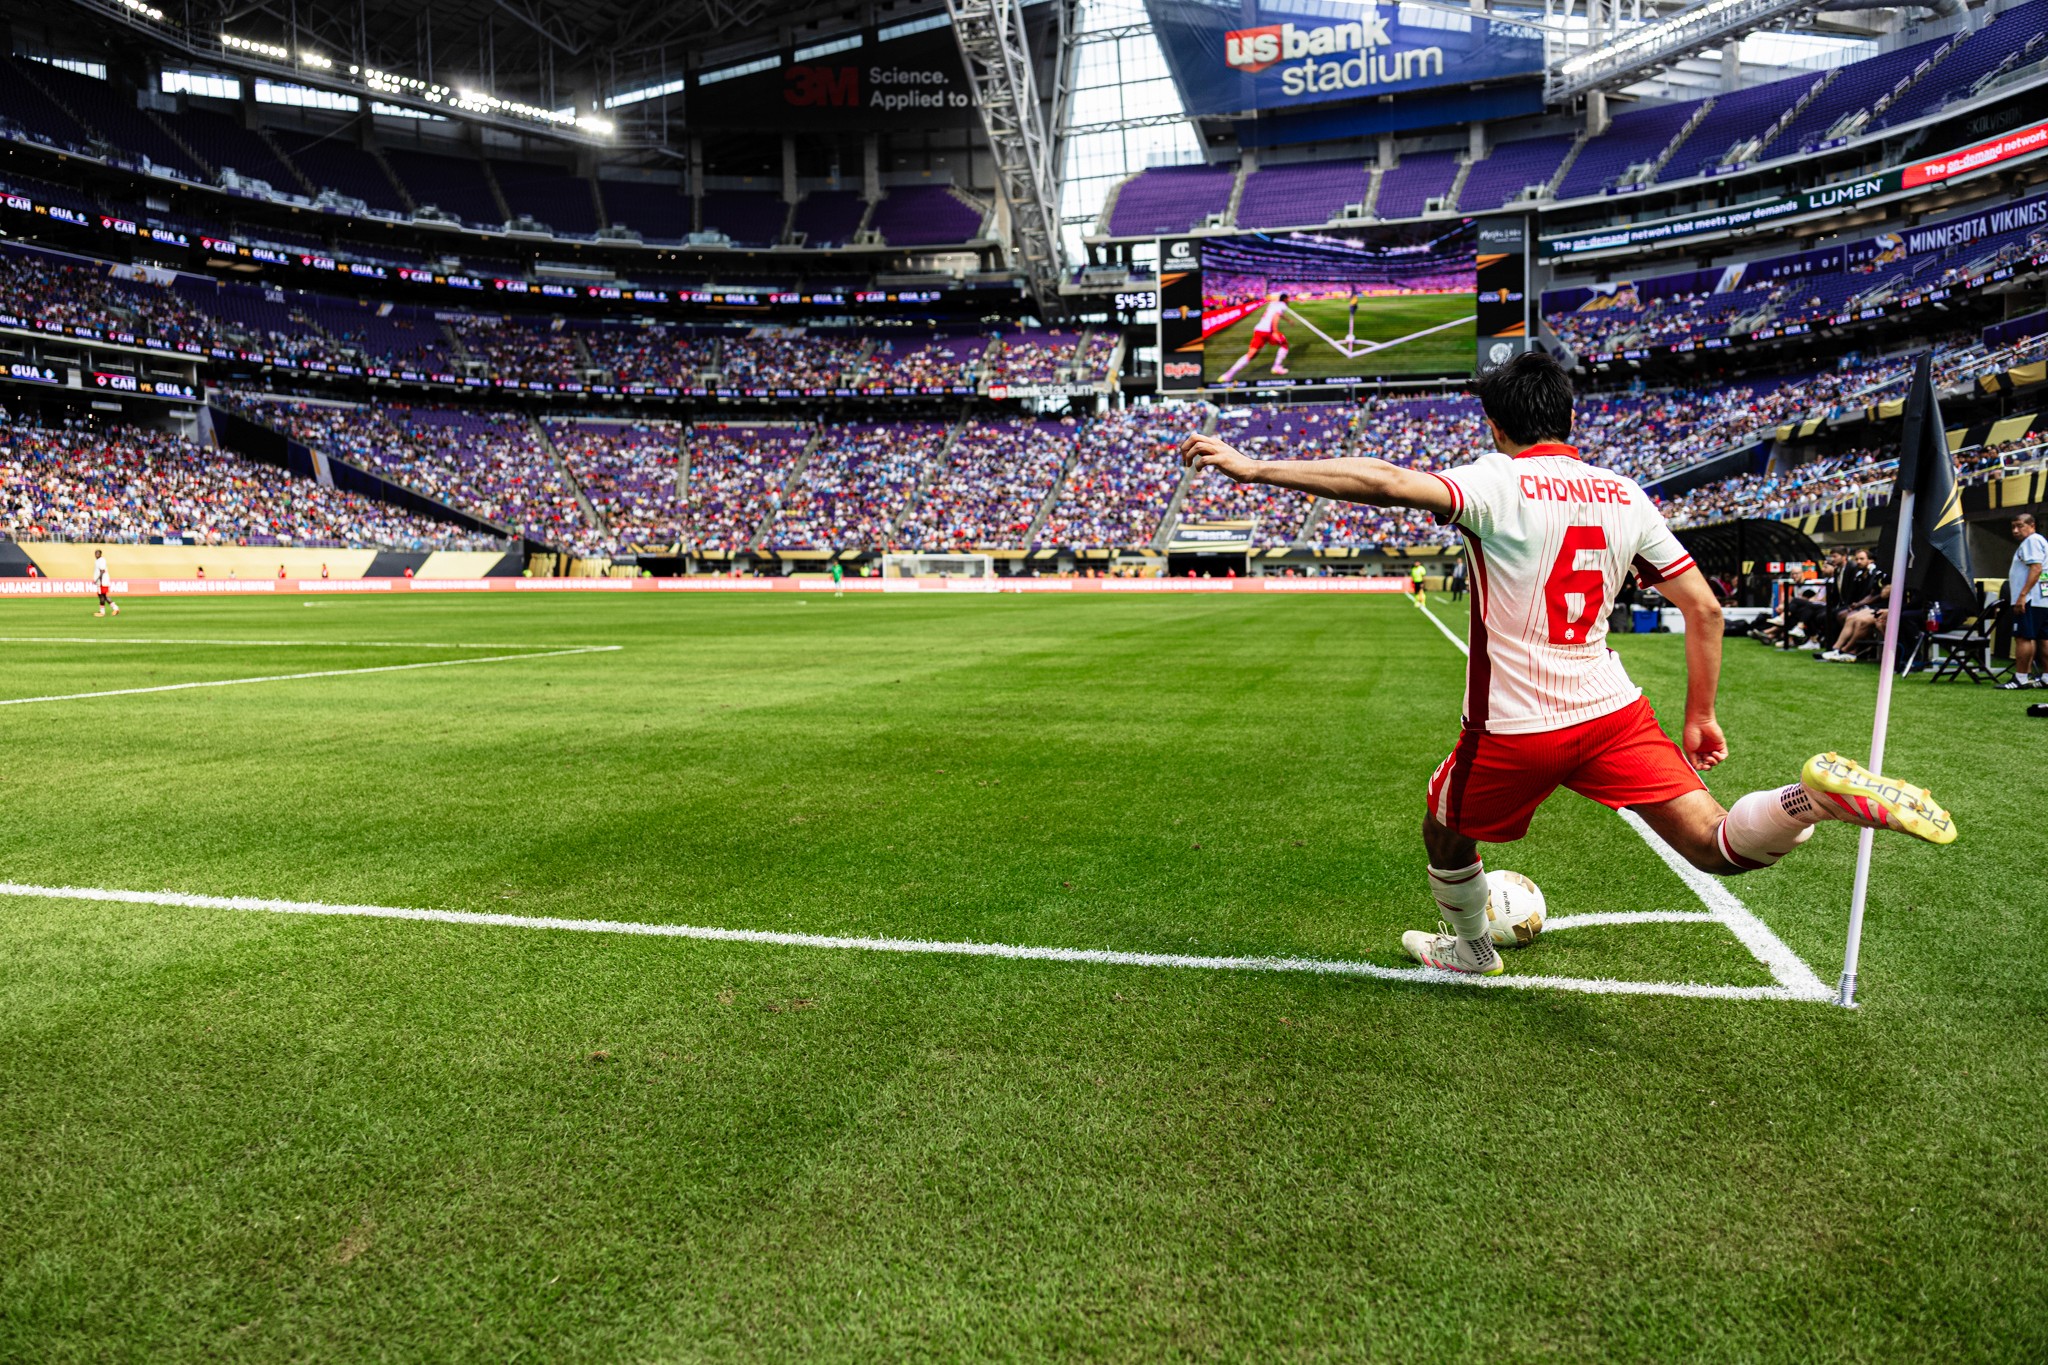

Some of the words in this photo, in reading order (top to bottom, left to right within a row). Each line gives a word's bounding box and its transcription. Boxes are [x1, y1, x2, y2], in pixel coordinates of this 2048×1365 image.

[870, 67, 949, 84] Science.
[1282, 46, 1443, 96] stadium
[784, 66, 860, 107] 3M
[870, 90, 944, 111] Applied
[947, 92, 968, 107] to
[1925, 163, 1945, 177] The
[1947, 143, 2003, 174] on-demand
[2004, 129, 2047, 153] network
[1809, 178, 1881, 209] LUMEN
[7, 196, 31, 211] CAN
[49, 206, 74, 220] GUA
[114, 221, 136, 235] CAN
[152, 229, 175, 242] GUA
[1552, 240, 1572, 252] The
[1573, 232, 1629, 250] on-demand
[1631, 226, 1672, 241] network
[1673, 220, 1693, 234] that
[1695, 215, 1727, 230] meets
[1728, 211, 1752, 226] your
[1752, 200, 1798, 219] demands
[1910, 216, 1988, 254] MINNESOTA
[1990, 200, 2047, 234] VIKINGS
[213, 240, 236, 254] CAN
[252, 248, 275, 262] GUA
[313, 258, 335, 271] CAN
[351, 263, 373, 275] GUA
[1772, 257, 1811, 276] HOME
[1821, 256, 1839, 269] OF
[1849, 249, 1875, 263] THE
[411, 272, 432, 283] CAN
[448, 276, 470, 288] GUA
[506, 281, 528, 293] CAN
[542, 285, 564, 296] GUA
[599, 288, 620, 299] CAN
[635, 290, 656, 301] GUA
[1115, 292, 1156, 309] 54:53
[11, 364, 40, 379] GUA
[110, 376, 137, 391] CAN
[155, 382, 181, 396] GUA
[0, 582, 41, 594] URANCE
[43, 581, 51, 593] IS
[53, 581, 63, 593] IN
[64, 581, 84, 593] OUR
[1544, 525, 1607, 645] 6
